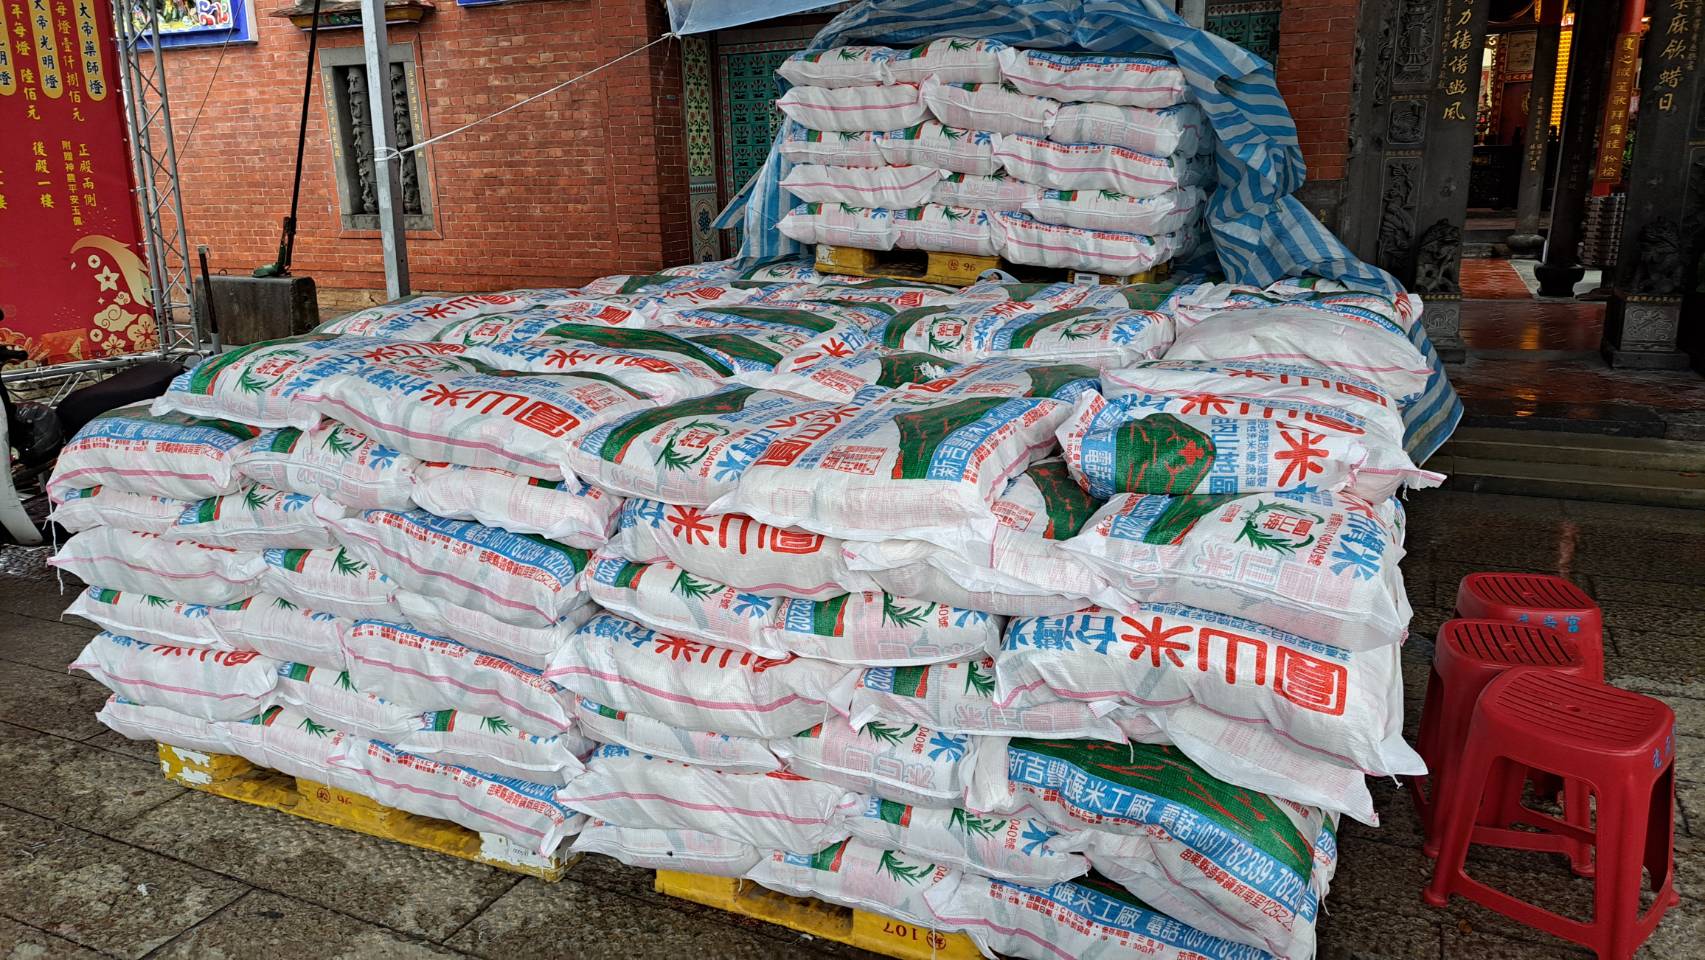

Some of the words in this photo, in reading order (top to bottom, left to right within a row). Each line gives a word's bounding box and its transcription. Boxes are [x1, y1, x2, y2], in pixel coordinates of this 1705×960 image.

[79, 2, 104, 95] 大帝藥師燈
[32, 140, 55, 209] 後殿一樓
[79, 143, 97, 207] 正殿兩側
[421, 383, 581, 438] 圓山米
[667, 505, 825, 555] 圓山米
[1262, 511, 1315, 537] 圓山牌
[1121, 614, 1348, 717] 圓山米
[1008, 749, 1157, 824] 新吉豐碾米工廠
[882, 921, 919, 941] 107
